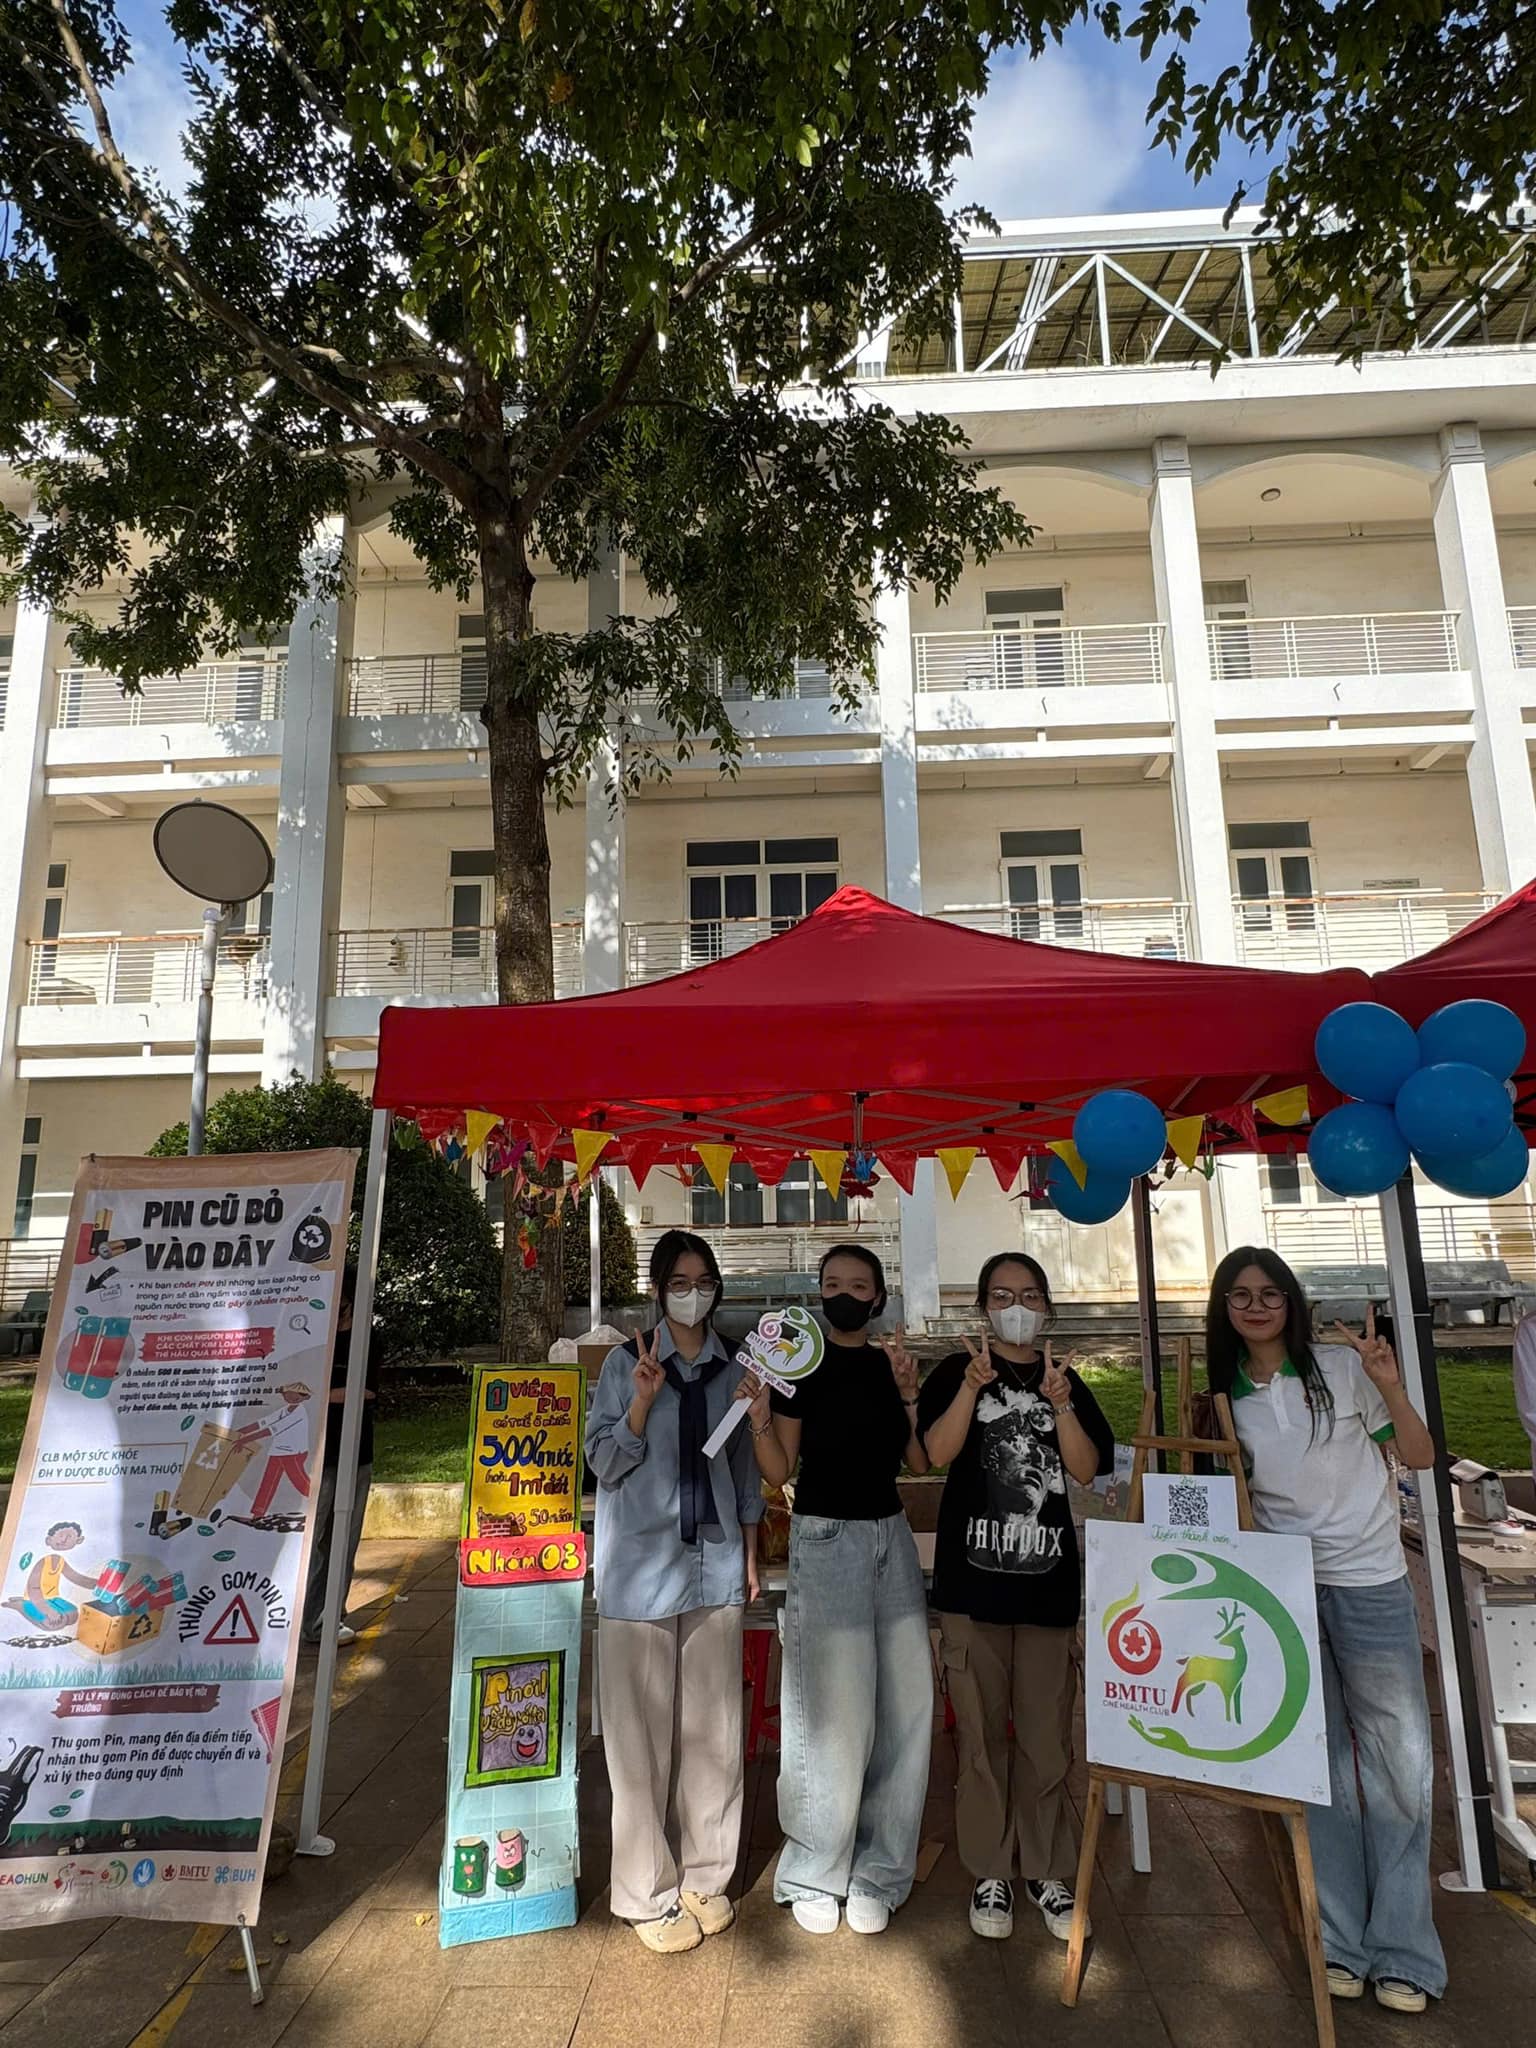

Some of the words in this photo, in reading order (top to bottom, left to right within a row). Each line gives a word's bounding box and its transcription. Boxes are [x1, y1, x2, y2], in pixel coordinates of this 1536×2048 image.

[142, 1200, 195, 1228] PIN
[200, 1192, 240, 1227] CŨ
[244, 1188, 284, 1224] BỎ
[144, 1236, 206, 1271] VÀO
[212, 1234, 275, 1269] ĐÂY
[138, 1281, 153, 1289] Khi
[267, 1361, 278, 1370] 50
[41, 1452, 60, 1463] CLB
[62, 1449, 87, 1464] MỘT
[88, 1447, 109, 1461] SỨC
[38, 1468, 54, 1479] ĐH
[56, 1468, 63, 1478] Y
[64, 1466, 97, 1479] DƯỢC
[97, 1464, 128, 1477] BUÔN
[129, 1464, 148, 1476] MA
[150, 1462, 184, 1475] THUỘT
[528, 1507, 550, 1527] 50
[966, 1516, 1065, 1562] PARADOX
[467, 1547, 537, 1575] Nhóm
[538, 1541, 582, 1572] 03
[221, 1570, 258, 1591] GOM
[254, 1576, 283, 1607] PIN
[176, 1584, 216, 1643] THÙNG
[267, 1606, 291, 1629] CŨ
[134, 1688, 156, 1699] CÁCH
[1104, 1680, 1168, 1707] BMTU
[1102, 1699, 1120, 1710] ONE
[1120, 1701, 1149, 1714] HEALTH
[1149, 1705, 1171, 1717] CLUB
[51, 1736, 73, 1749] Thu
[76, 1738, 100, 1751] gom
[104, 1733, 125, 1746] Pin,
[128, 1733, 161, 1746] mang
[164, 1729, 184, 1744] đến
[185, 1730, 200, 1746] địa
[202, 1728, 229, 1744] điểm
[231, 1728, 253, 1745] tiếp
[47, 1753, 76, 1769] nhận
[79, 1752, 99, 1765] thu
[102, 1752, 127, 1766] gom
[129, 1749, 149, 1762] Pin
[151, 1745, 168, 1761] để
[168, 1747, 193, 1764] được
[195, 1745, 232, 1764] chuyển
[235, 1747, 246, 1760] đi
[248, 1746, 261, 1760] và
[43, 1770, 59, 1784] xử
[61, 1769, 73, 1786] lý
[75, 1769, 102, 1782] theo
[104, 1767, 133, 1783] đúng
[136, 1768, 158, 1783] quy
[160, 1765, 184, 1781] định
[179, 1864, 211, 1878] BMTU
[231, 1867, 257, 1882] BUH
